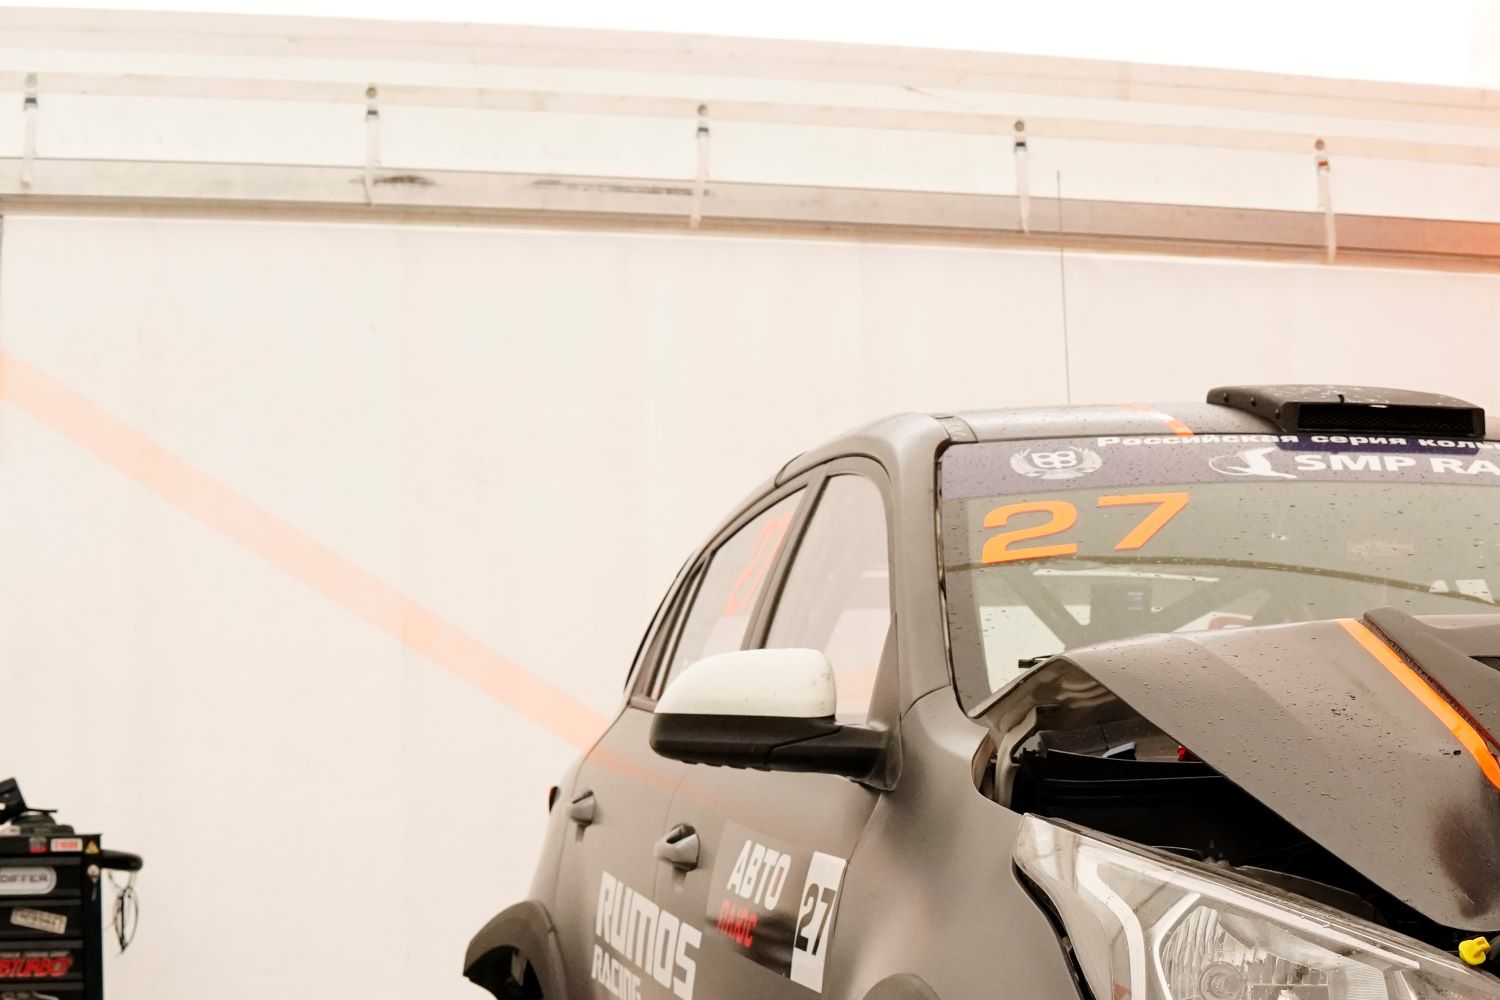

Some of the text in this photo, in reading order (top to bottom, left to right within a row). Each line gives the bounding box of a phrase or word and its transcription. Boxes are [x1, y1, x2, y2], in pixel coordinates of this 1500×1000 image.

[1097, 435, 1299, 447] Российская
[1311, 435, 1408, 446] серия
[1294, 454, 1417, 472] SMP
[982, 492, 1190, 564] 27
[726, 839, 792, 911] АВТО
[795, 883, 836, 956] 27
